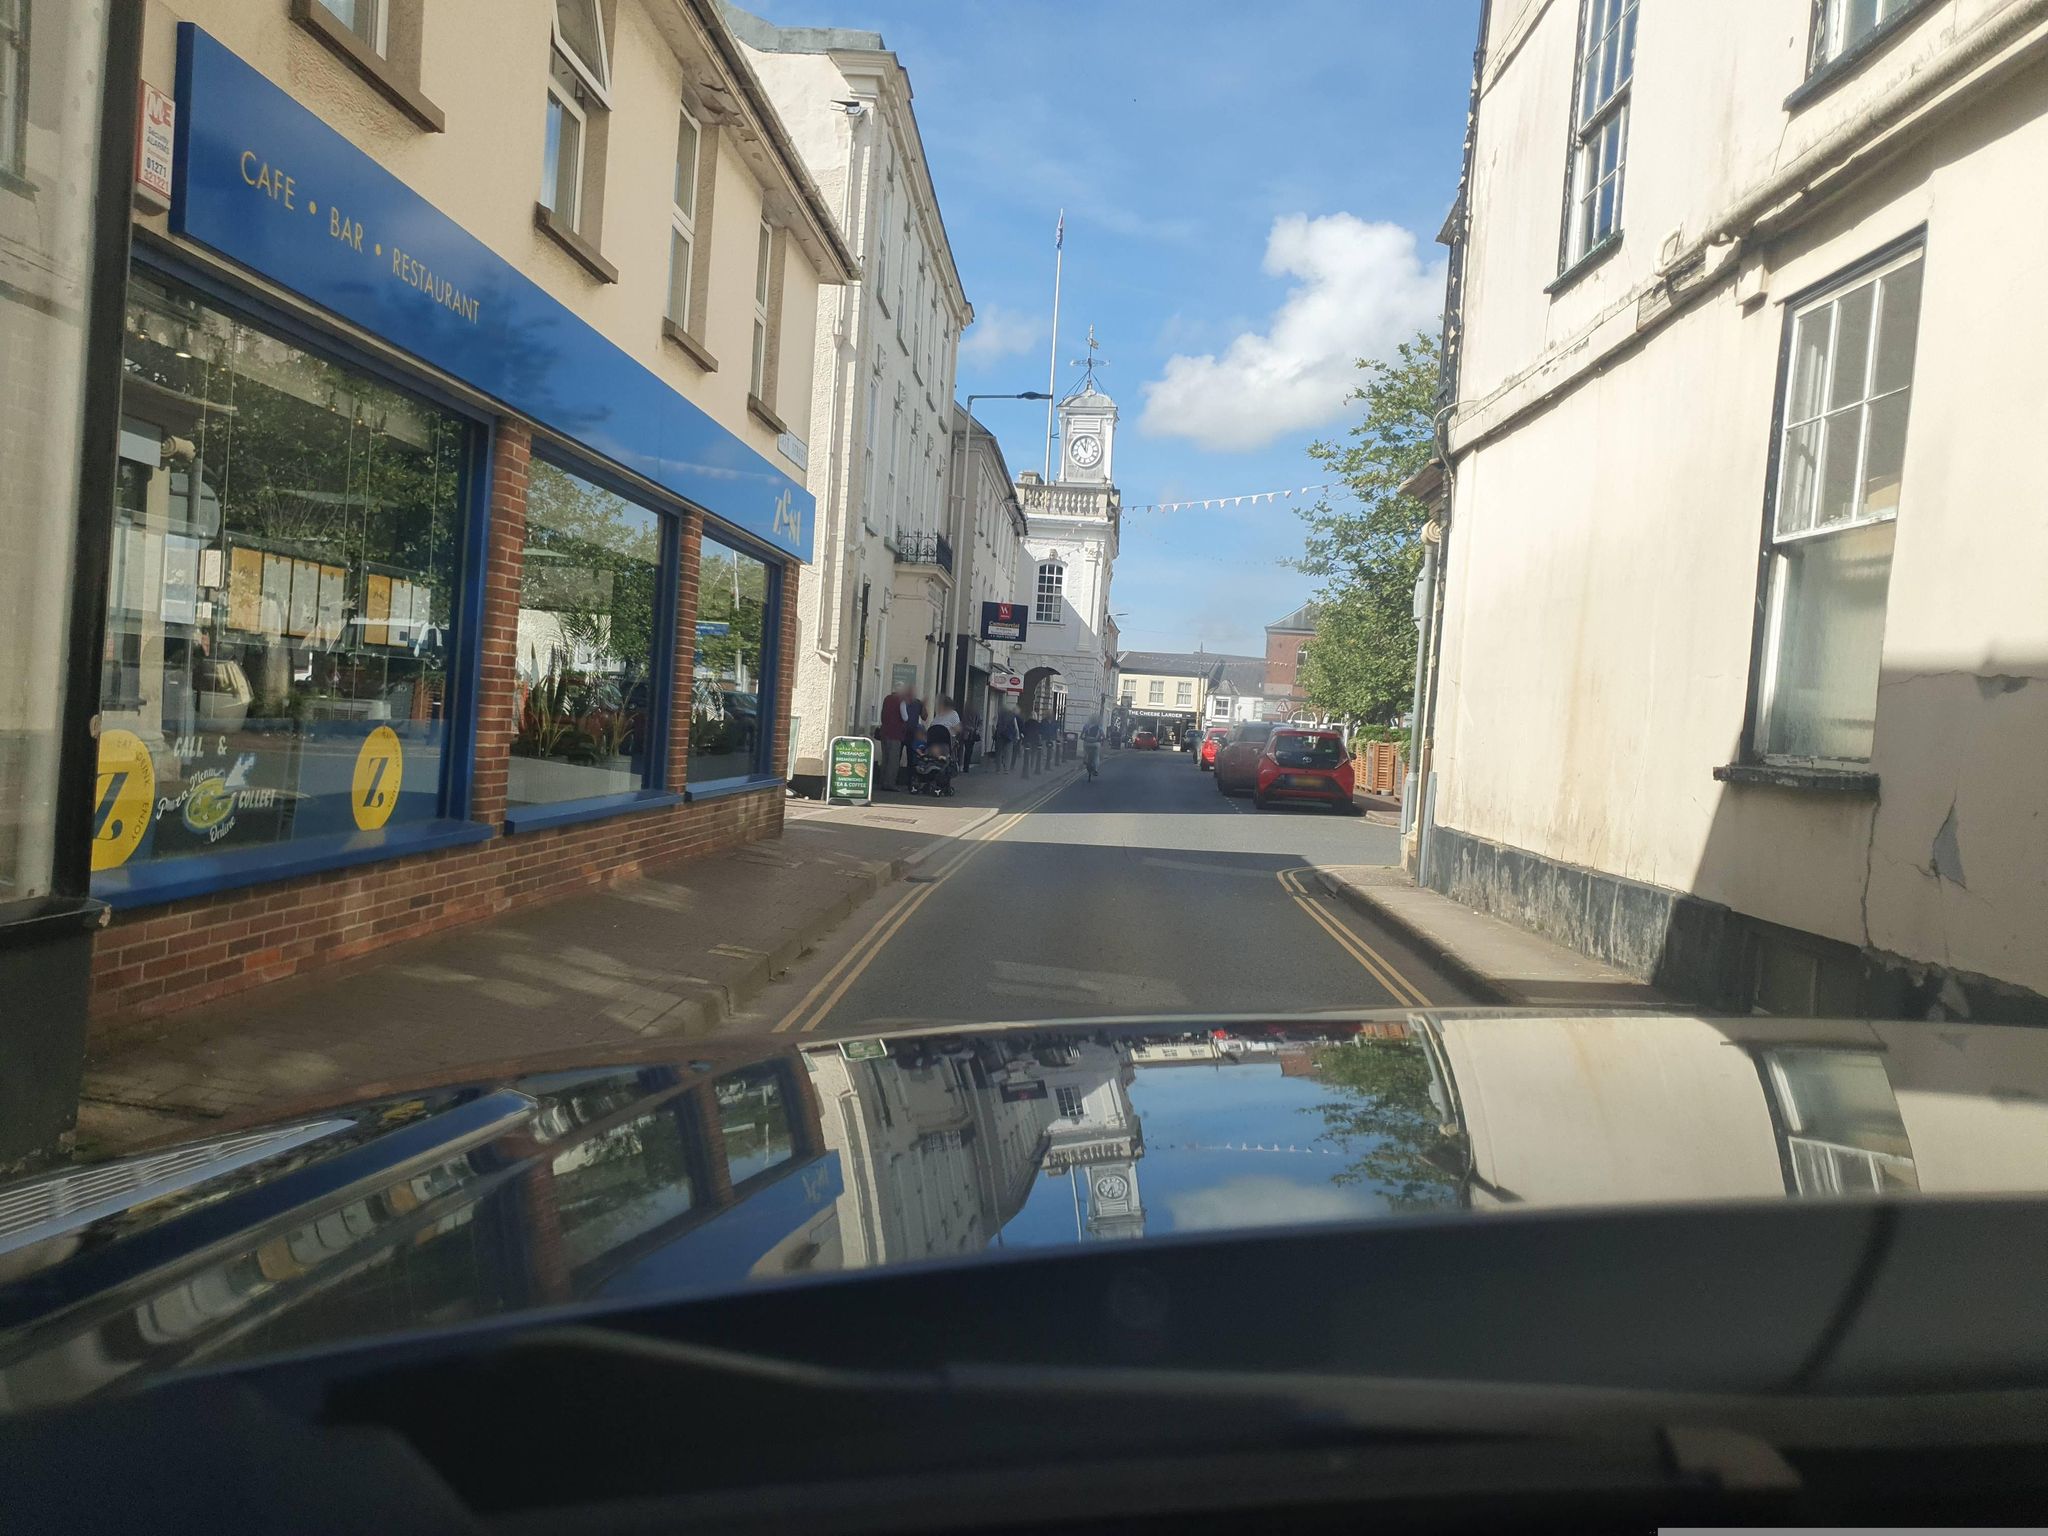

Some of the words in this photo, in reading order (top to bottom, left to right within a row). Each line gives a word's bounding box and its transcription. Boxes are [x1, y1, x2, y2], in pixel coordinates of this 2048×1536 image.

[146, 157, 167, 178] 01271
[240, 151, 296, 210] CAFE
[329, 206, 364, 254] BAR
[392, 248, 481, 325] RESTAURANT
[173, 736, 204, 757] CALL
[217, 735, 228, 755] &
[363, 757, 389, 808] Z
[238, 789, 277, 808] COLLECT
